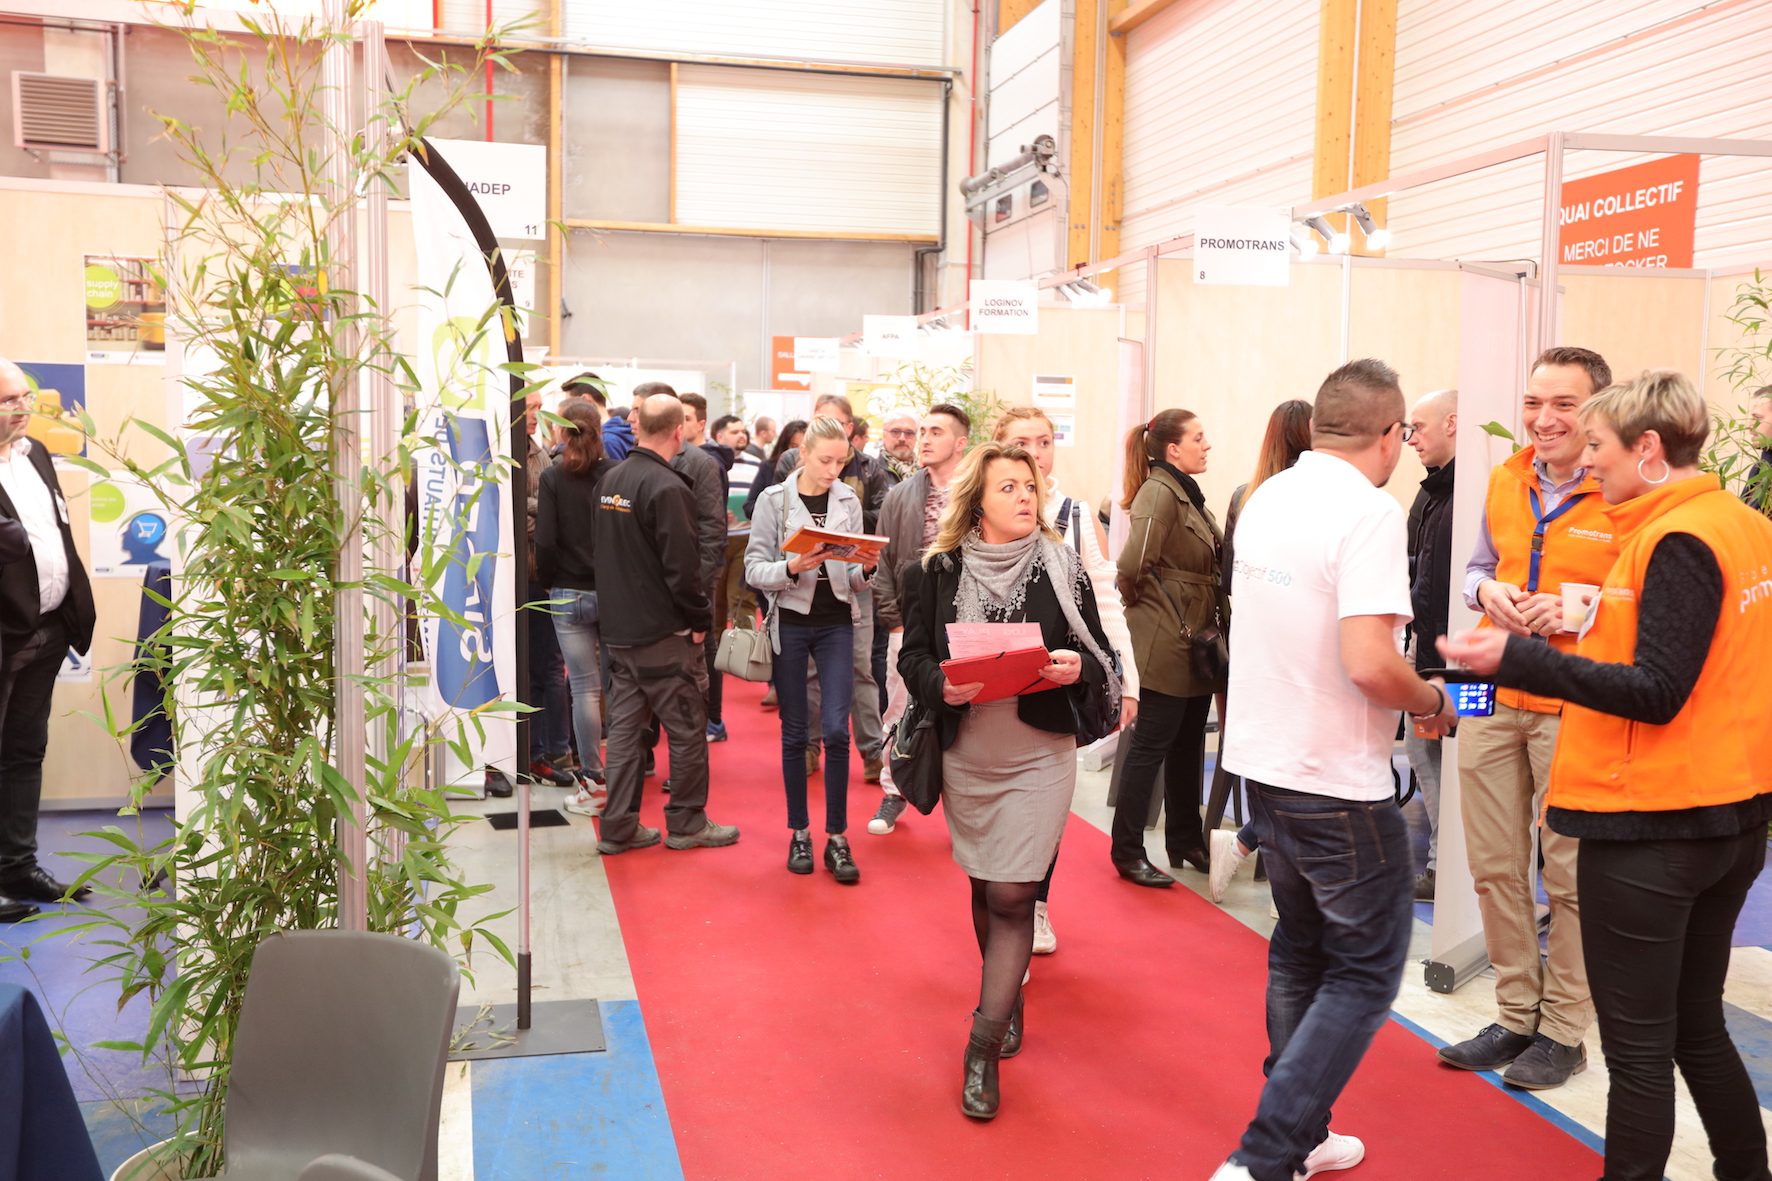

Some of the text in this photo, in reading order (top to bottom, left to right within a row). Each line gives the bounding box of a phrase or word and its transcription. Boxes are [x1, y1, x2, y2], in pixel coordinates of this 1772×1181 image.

[1593, 180, 1684, 218] COLLECTIF
[525, 224, 538, 236] 11
[1200, 238, 1285, 251] PROMOTRANS
[1564, 228, 1661, 262] MERCI DE NE
[1199, 270, 1206, 280] 8
[86, 280, 119, 290] supply
[86, 289, 114, 298] chain
[984, 299, 1024, 307] LOGINOV
[978, 308, 1029, 316] FORMATION
[1568, 526, 1613, 540] Promotrans
[1267, 569, 1292, 587] 500
